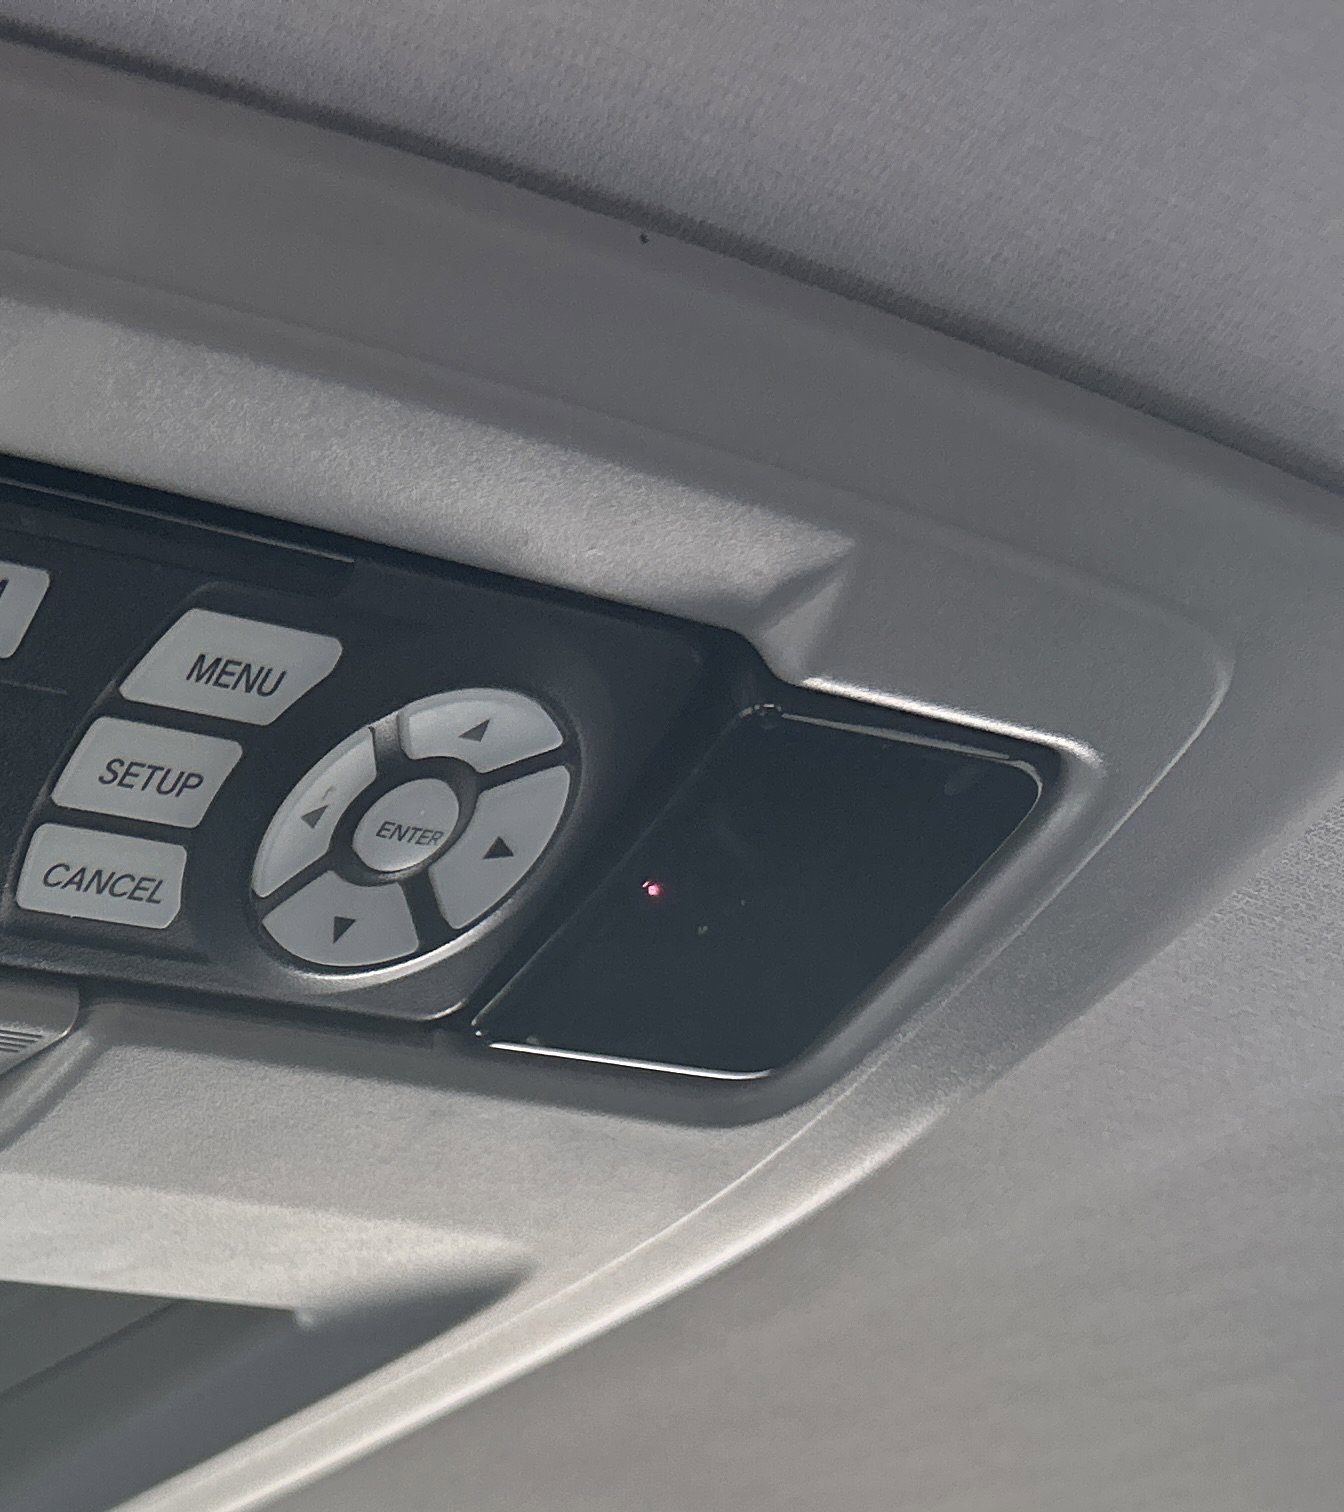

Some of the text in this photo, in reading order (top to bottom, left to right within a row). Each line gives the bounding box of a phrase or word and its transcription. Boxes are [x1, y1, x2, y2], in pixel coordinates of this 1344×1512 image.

[186, 653, 286, 697] MENU
[98, 757, 204, 799] SETUP
[375, 820, 444, 848] ENTER
[42, 862, 167, 905] CANCEL
